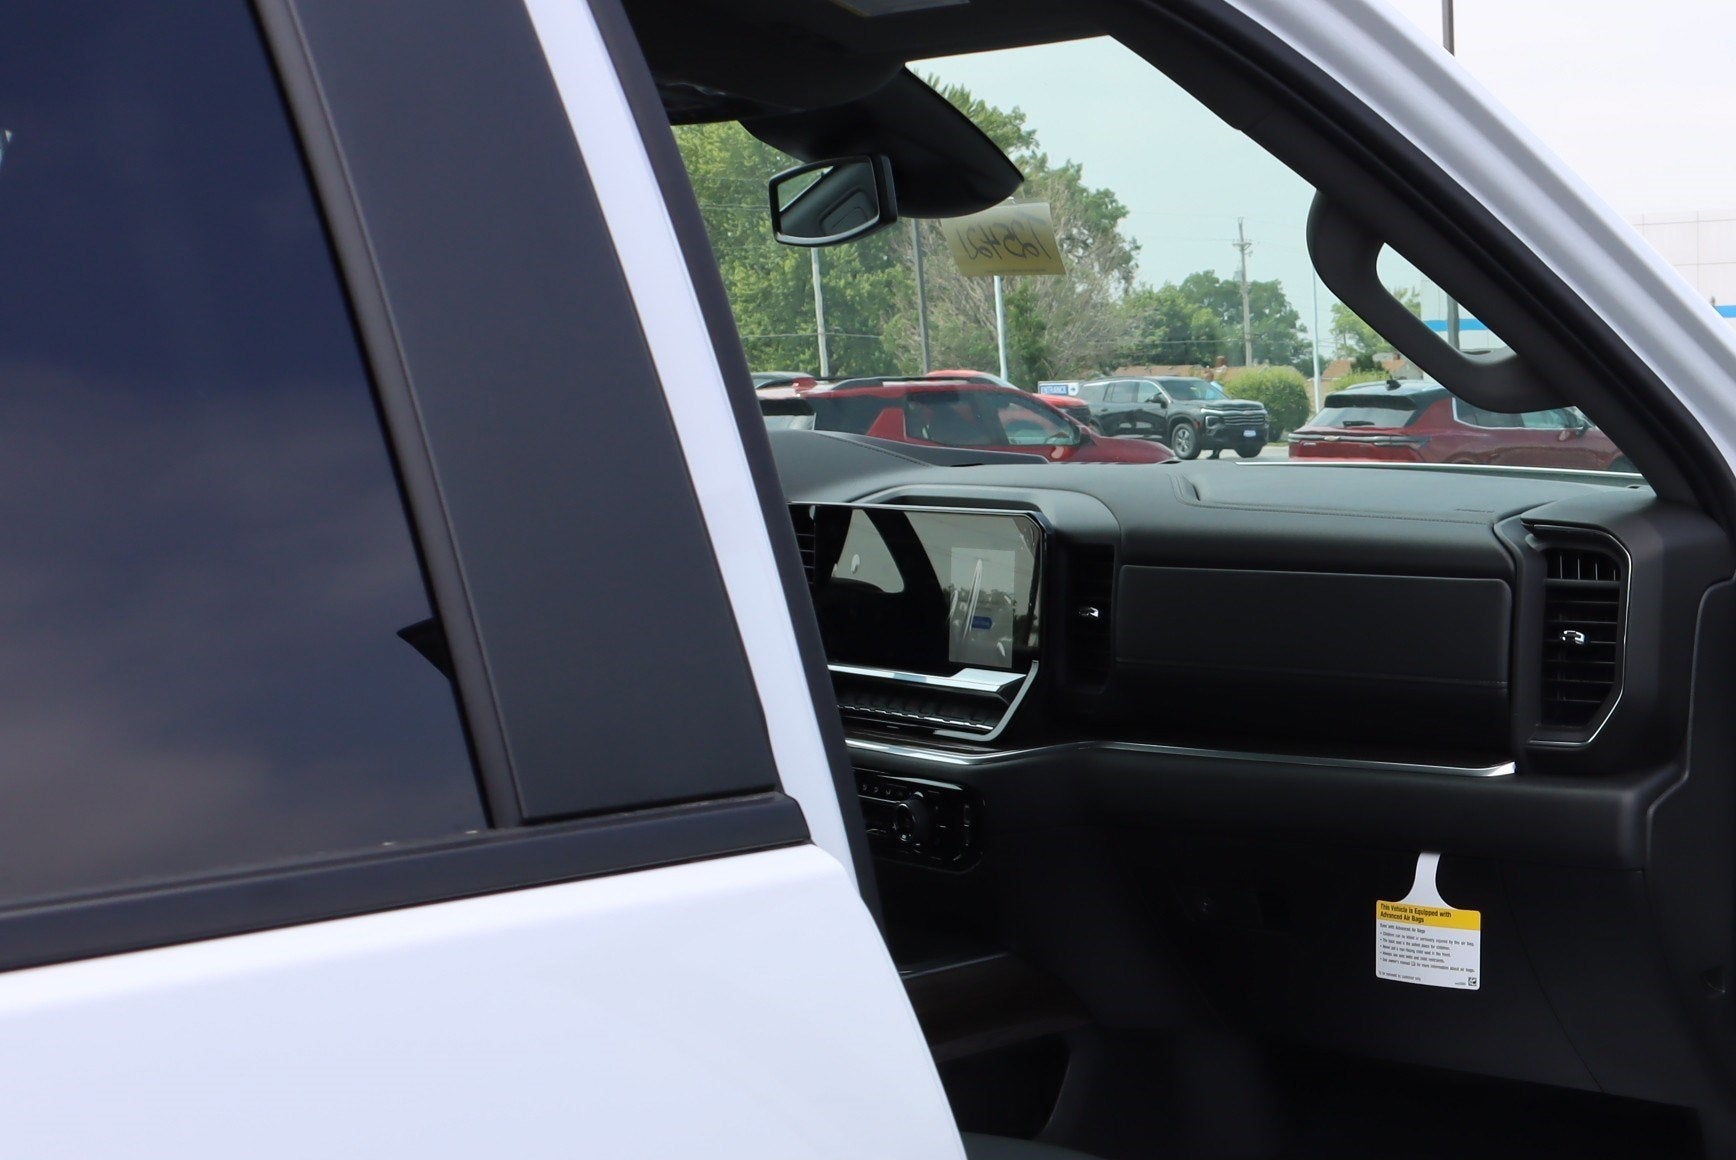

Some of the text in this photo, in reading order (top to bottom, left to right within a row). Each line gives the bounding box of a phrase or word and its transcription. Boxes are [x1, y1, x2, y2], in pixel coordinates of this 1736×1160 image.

[1381, 903, 1390, 911] This
[1391, 905, 1408, 914] Vehicle
[1415, 908, 1439, 917] Equipped
[1381, 911, 1403, 920] Advanced
[1412, 915, 1425, 924] Bags
